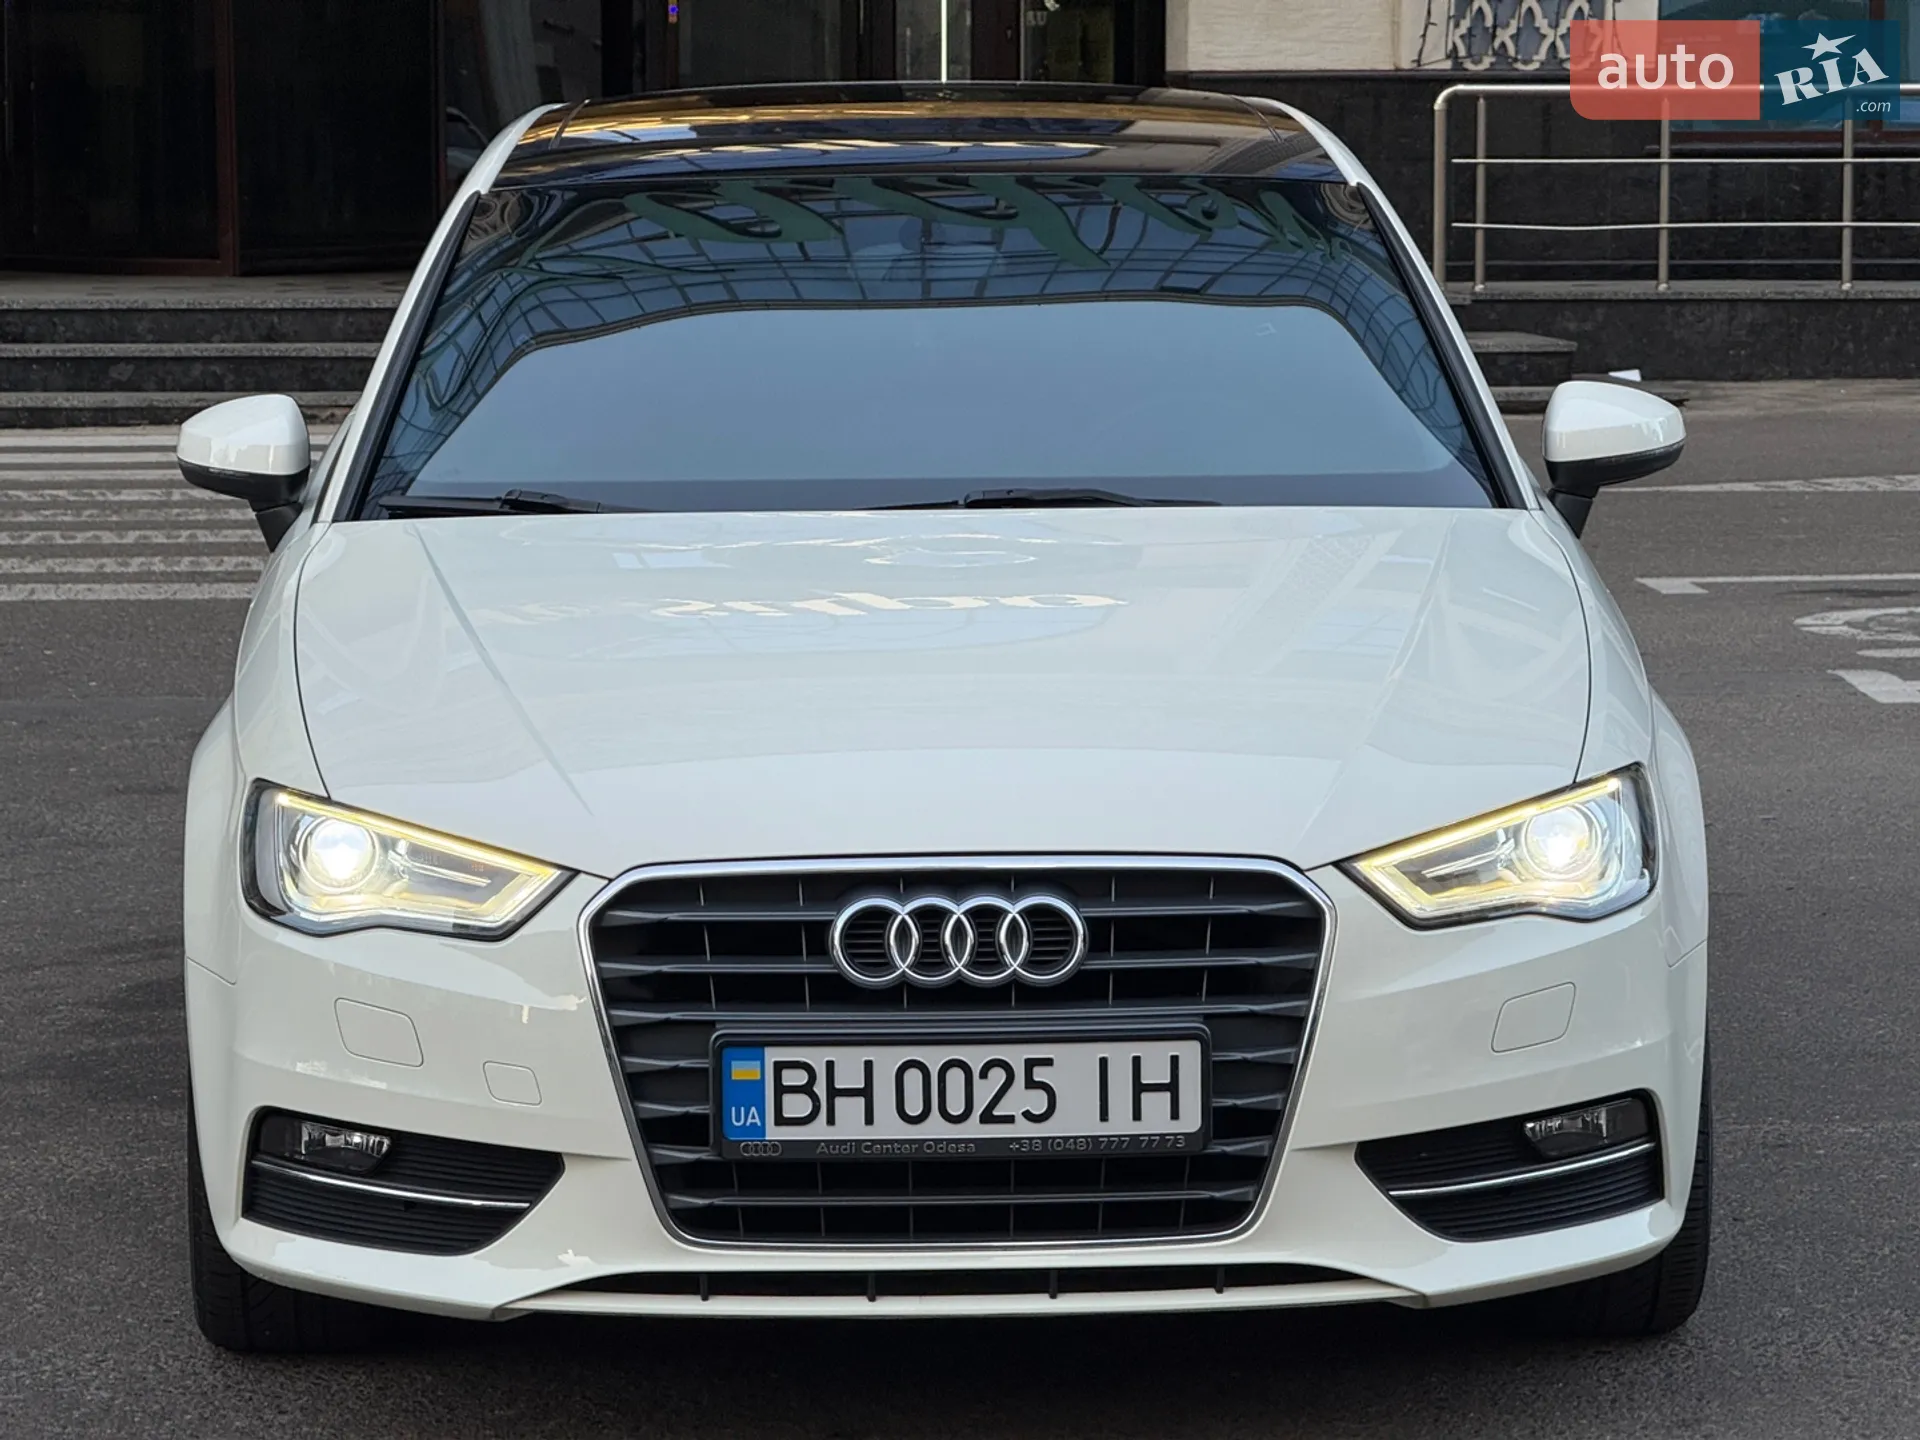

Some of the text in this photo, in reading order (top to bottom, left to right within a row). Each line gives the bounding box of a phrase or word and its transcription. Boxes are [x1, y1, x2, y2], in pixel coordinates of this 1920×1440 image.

[772, 1053, 1181, 1127] BH 0025 IH
[731, 1106, 761, 1127] UA
[816, 1135, 1186, 1154] Audi Center Odesa +38 (048) 777 77 73
